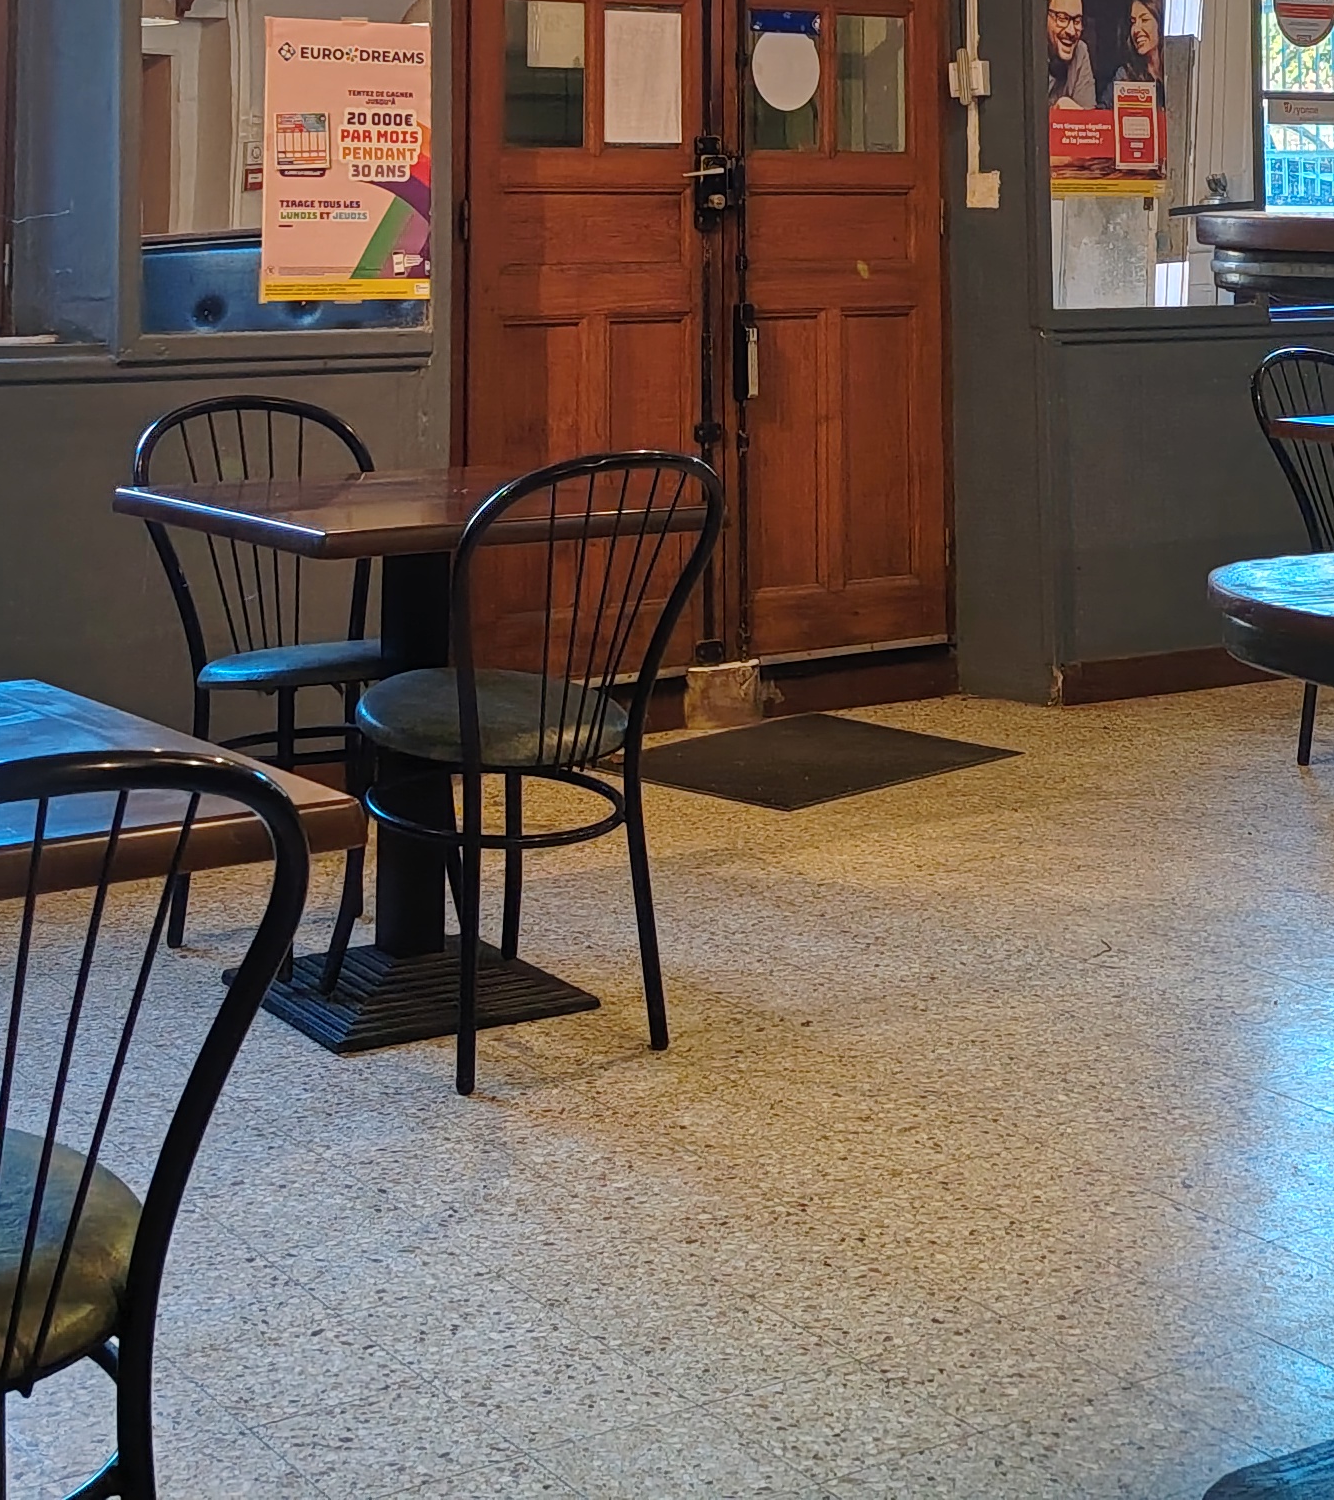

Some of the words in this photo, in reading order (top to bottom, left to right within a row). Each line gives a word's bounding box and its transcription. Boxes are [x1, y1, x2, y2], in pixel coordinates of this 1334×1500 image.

[300, 46, 344, 60] EURO
[359, 50, 425, 64] DREAMS
[347, 111, 367, 125] 20
[371, 112, 414, 127] 000€
[340, 129, 373, 143] PAR
[376, 130, 418, 144] MOIS
[342, 146, 416, 161] PENDANT
[351, 164, 372, 177] 30
[374, 164, 407, 178] ANS
[279, 200, 316, 208] TIRAGE
[317, 200, 342, 208] TOUS
[343, 200, 361, 209] LES
[280, 211, 318, 220] LUNDIS
[319, 211, 331, 220] ET
[332, 211, 368, 220] JEUDIS
